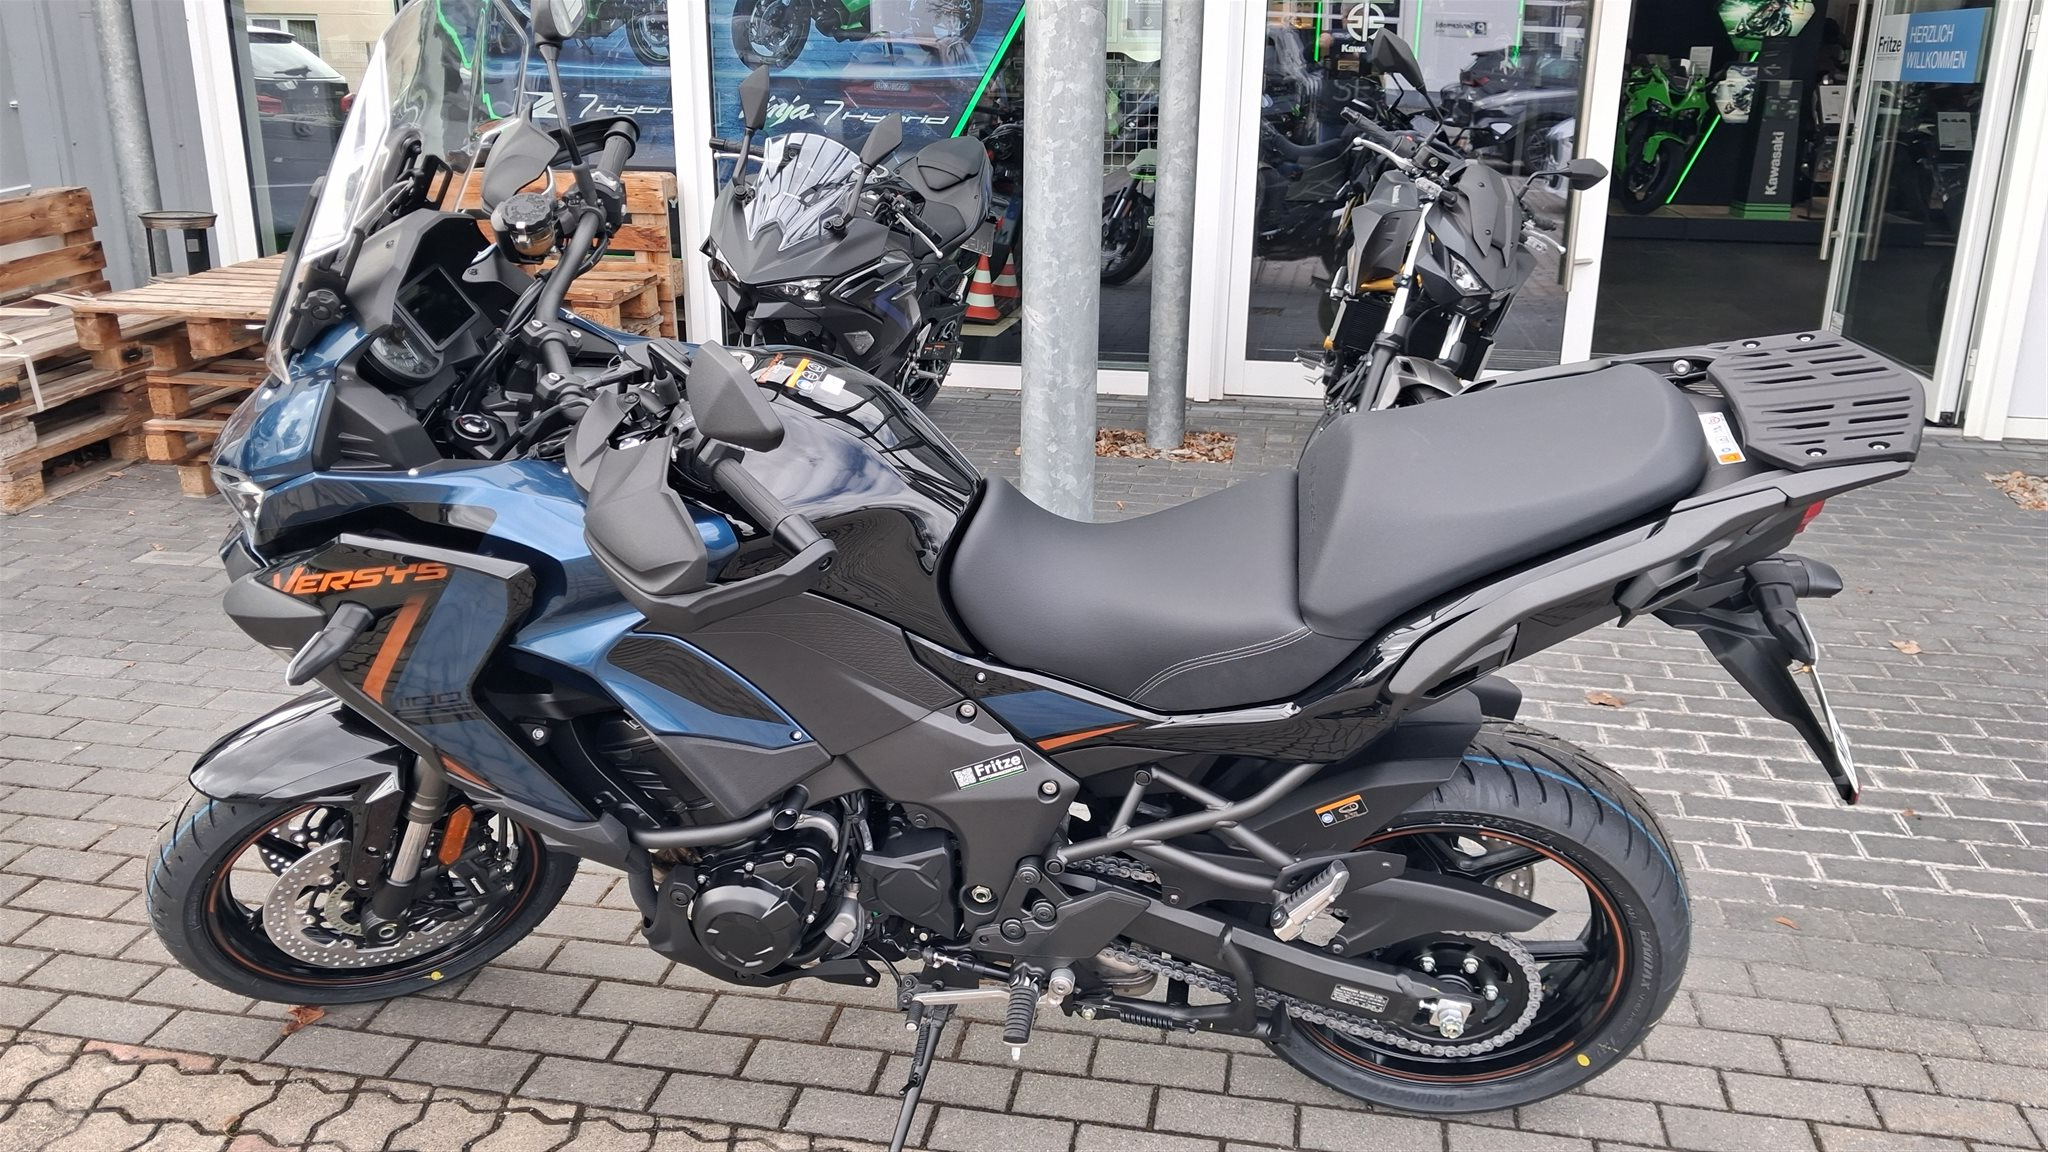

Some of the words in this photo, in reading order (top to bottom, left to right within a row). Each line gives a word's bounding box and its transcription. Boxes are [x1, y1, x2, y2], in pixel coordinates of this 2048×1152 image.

[1910, 24, 1955, 43] HERZLICH
[1341, 44, 1367, 53] Kawa
[1878, 37, 1902, 53] Fritze
[1906, 51, 1968, 69] WILLKOMMEN
[579, 93, 598, 118] 7
[596, 104, 673, 115] Hybr
[738, 95, 815, 127] inja
[823, 100, 845, 126] 7
[841, 112, 950, 125] Hyrid
[1764, 131, 1785, 195] Kawasaki
[272, 563, 448, 595] VERSYS
[974, 755, 1021, 777] Fritze
